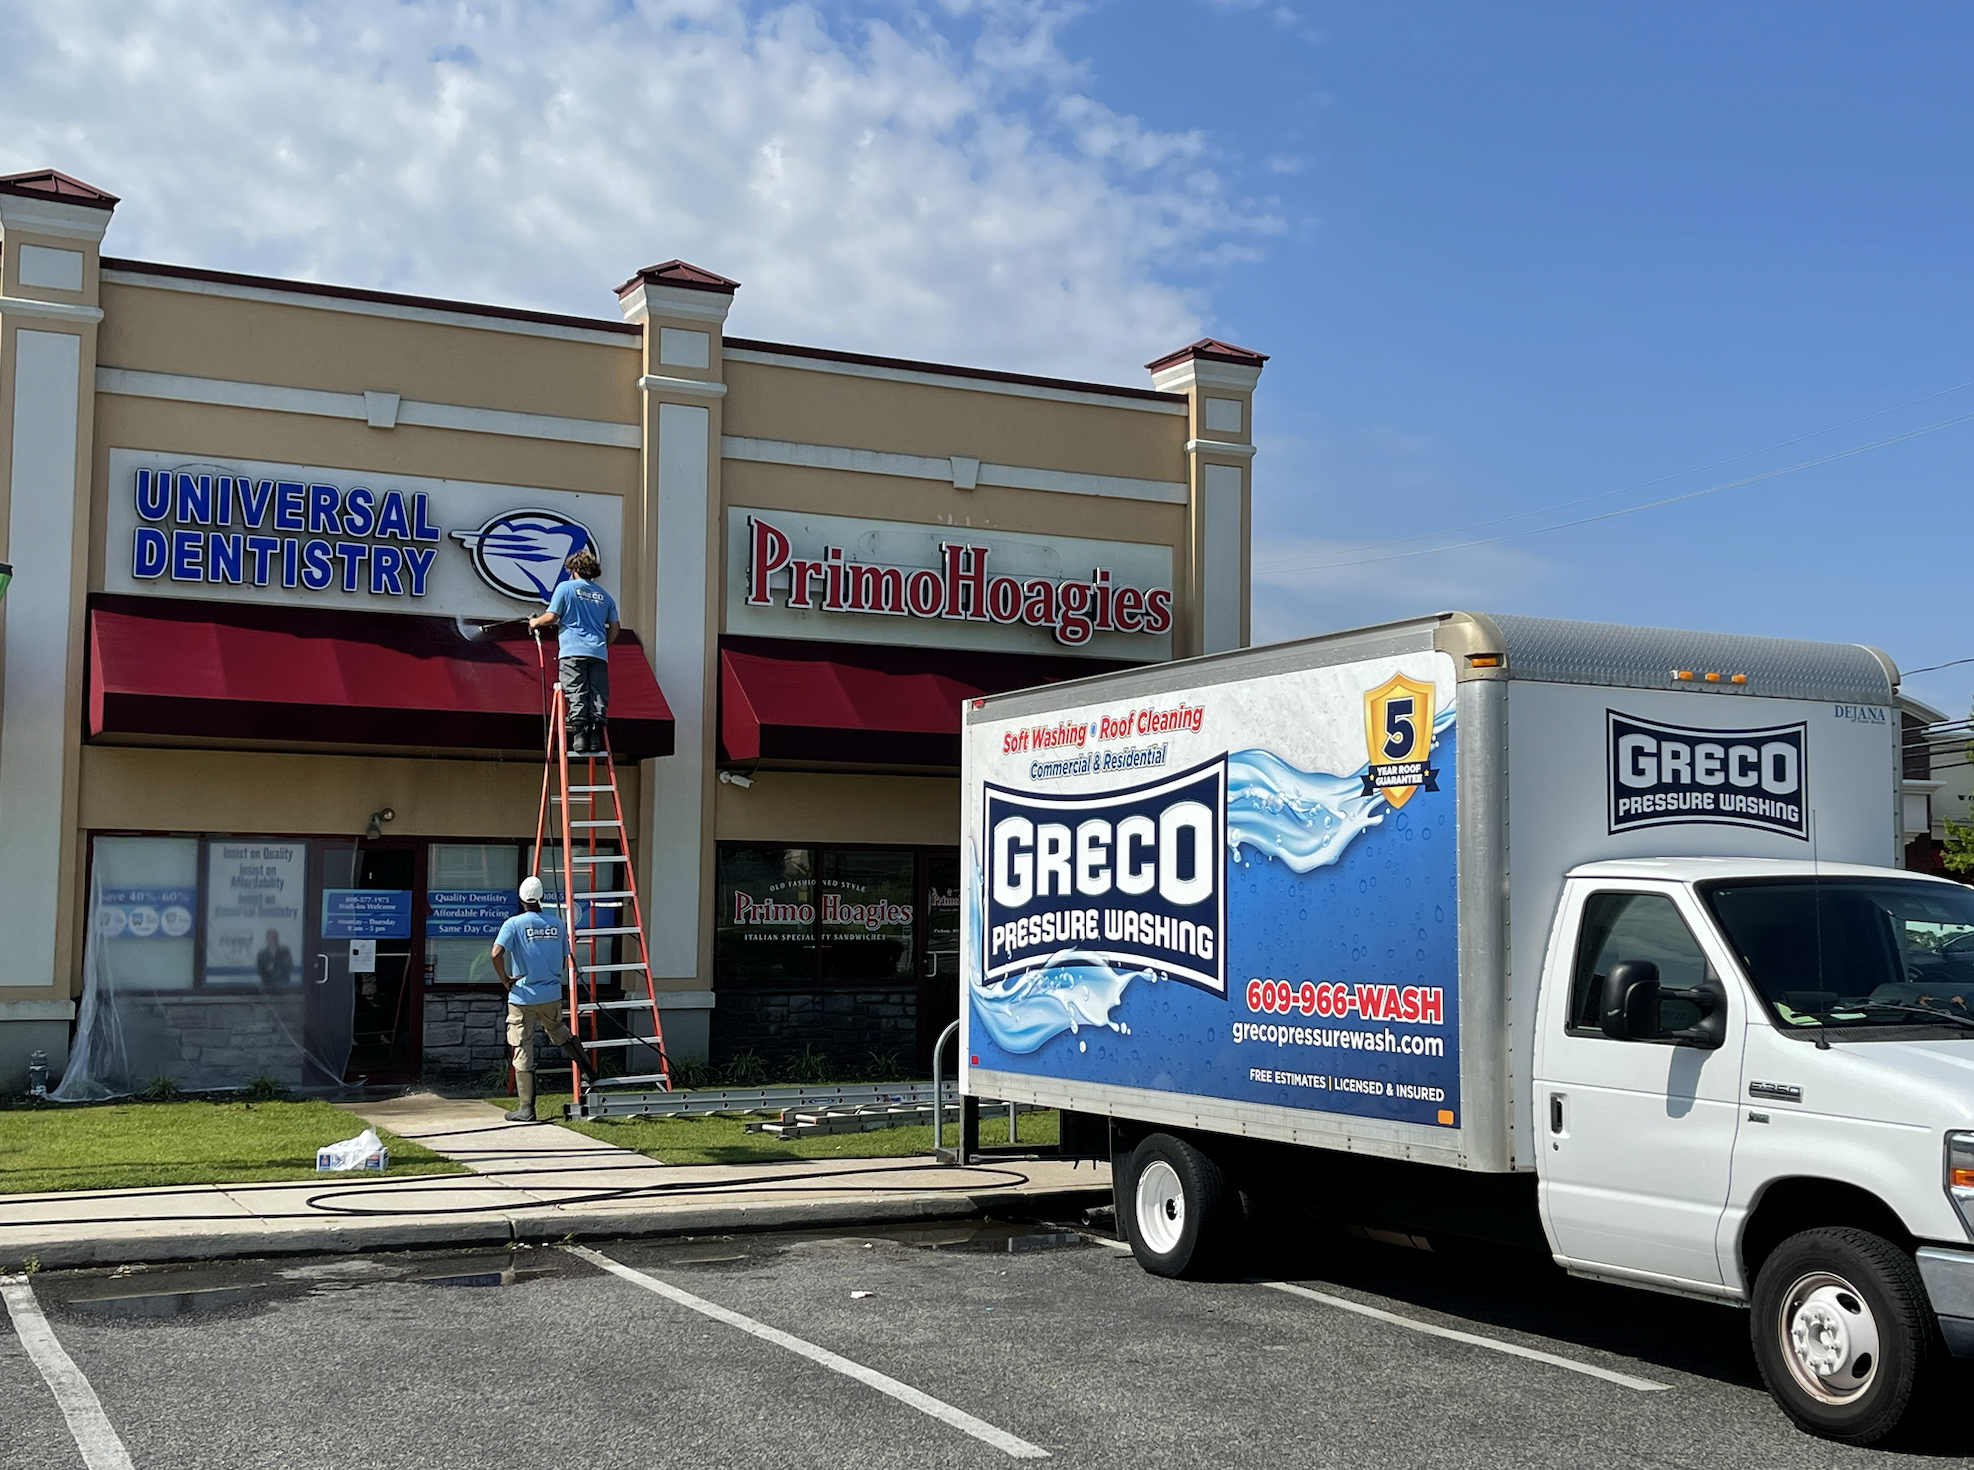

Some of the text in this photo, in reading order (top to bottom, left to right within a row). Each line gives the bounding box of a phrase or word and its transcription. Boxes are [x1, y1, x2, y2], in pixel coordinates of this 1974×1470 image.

[136, 468, 440, 542] UNIVERSAL
[133, 526, 438, 596] DENTISTRY
[747, 514, 1173, 646] PrimoHoagies
[1003, 703, 1204, 755] Soft Washing Roof Cleaning
[1382, 697, 1416, 761] 5
[1834, 704, 1886, 722] DEJANA
[1030, 742, 1168, 781] Commercial & Residential
[1377, 764, 1421, 775] YEAR ROOF
[1618, 733, 1798, 795] GRECO
[1375, 774, 1422, 786] GUARANTEE
[1618, 792, 1799, 822] PRESSURE WASHING
[250, 849, 261, 859] on
[263, 847, 294, 862] Quality
[265, 866, 277, 876] on
[993, 801, 1213, 908] GRECO
[435, 893, 508, 903] Quality Dentistry
[769, 882, 785, 892] OLD
[841, 881, 867, 893] STYLE
[369, 918, 396, 927] Thursday
[433, 908, 510, 919] Affordable Pricing
[734, 890, 914, 931] Primo Hoagies
[439, 924, 461, 933] Same
[463, 924, 480, 935] Day
[992, 908, 1214, 960] PRESSURE WASHING
[1246, 978, 1444, 1025] 609-966-WASH
[1232, 1022, 1443, 1057] grecopressurewash.com
[1250, 1068, 1445, 1102] FREE ESTIMATES LICENSED & INSURED
